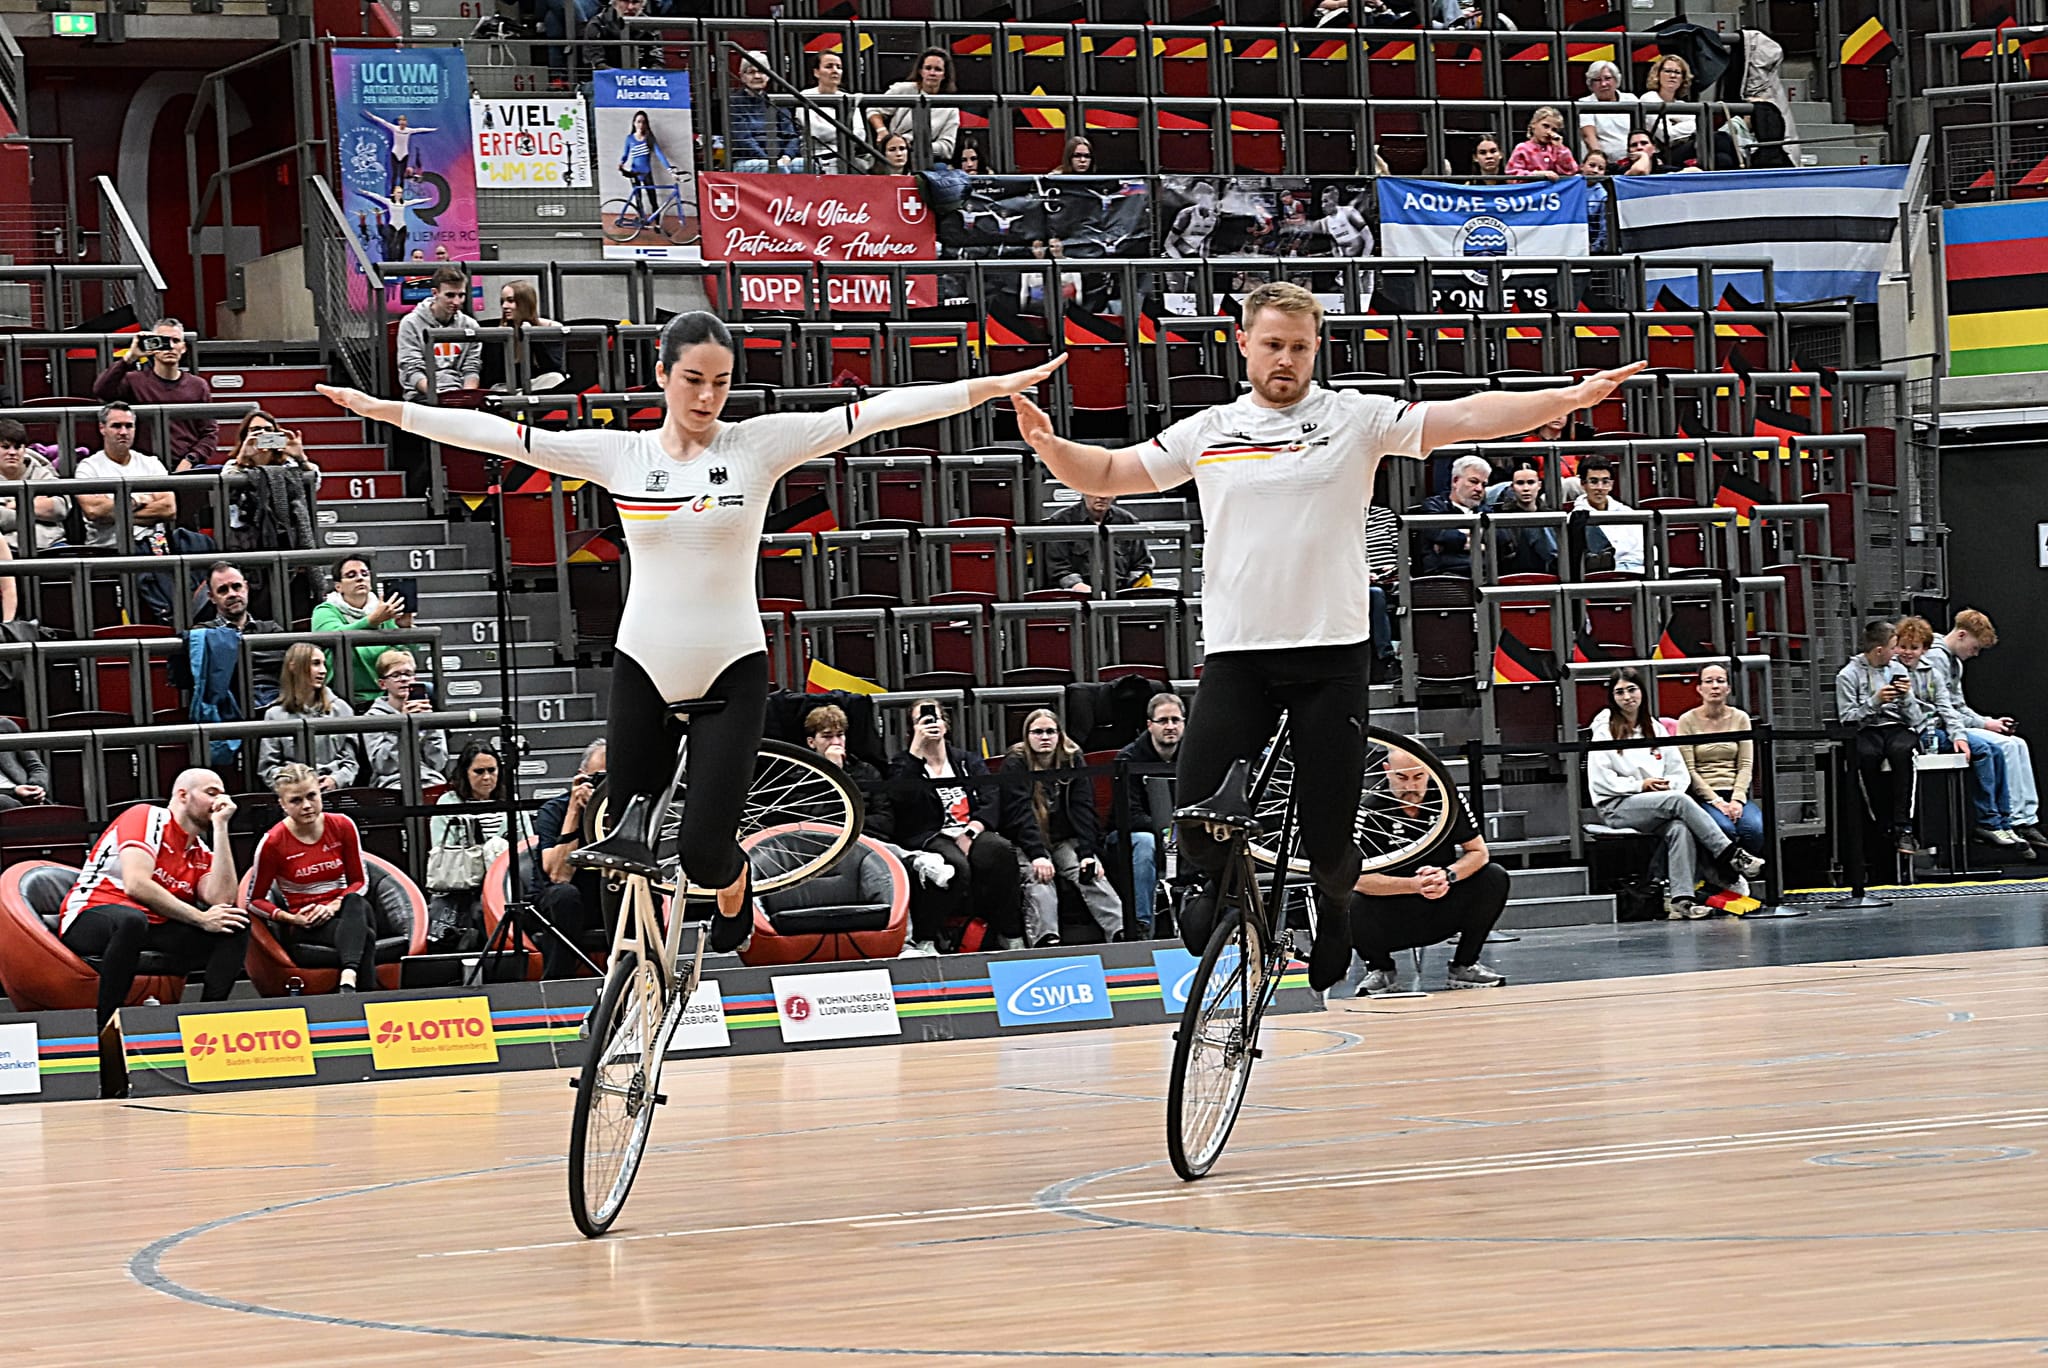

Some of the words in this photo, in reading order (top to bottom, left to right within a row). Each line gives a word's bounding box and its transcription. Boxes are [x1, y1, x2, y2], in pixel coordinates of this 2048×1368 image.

[460, 2, 481, 17] G1
[361, 63, 394, 83] UCI
[400, 63, 438, 83] WM
[514, 75, 536, 91] G1
[615, 75, 637, 87] Viel
[638, 75, 667, 87] Glück
[362, 85, 400, 95] ARTISTIC
[402, 84, 438, 95] CYCLING
[616, 89, 670, 101] Alexandra
[499, 105, 555, 127] VIEL
[479, 131, 563, 156] ERFOLG
[489, 162, 527, 182] WM
[767, 196, 812, 227] Viel
[817, 199, 871, 227] Glück
[1403, 192, 1487, 213] AQUAE
[1495, 192, 1561, 213] SULIS
[724, 227, 807, 256] Patricia
[812, 235, 834, 256] &
[841, 231, 918, 260] Andrea
[350, 478, 376, 499] G1
[409, 549, 436, 570] G1
[472, 621, 499, 642] G1
[538, 699, 566, 721] G1
[295, 858, 344, 878] AUSTRIA
[816, 992, 892, 1006] WOHNUNGSBAU
[1030, 982, 1094, 1007] SWLB
[819, 1003, 890, 1016] LUDWIGSBURG
[408, 1017, 485, 1040] LOTTO
[222, 1029, 302, 1053] LOTTO
